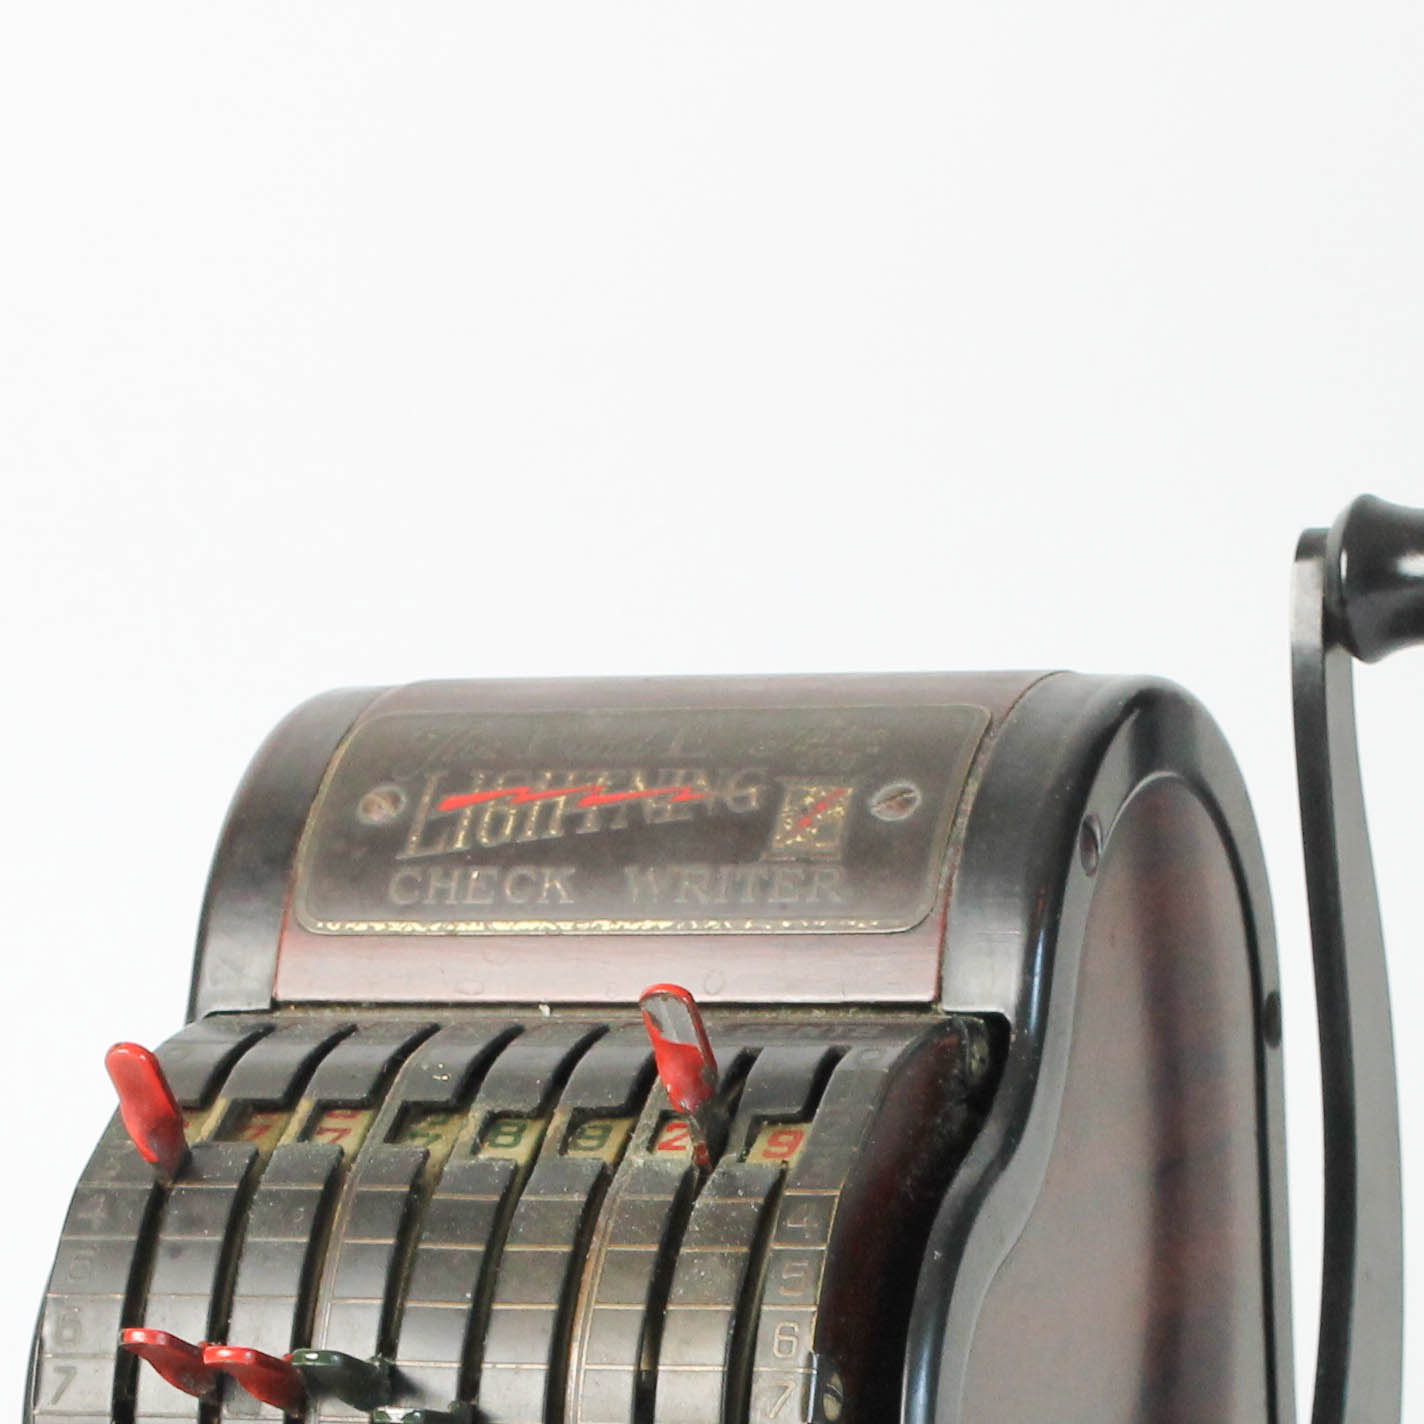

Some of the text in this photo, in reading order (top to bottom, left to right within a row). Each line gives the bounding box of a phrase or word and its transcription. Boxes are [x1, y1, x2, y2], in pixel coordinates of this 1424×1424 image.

[395, 768, 768, 860] LIGHTNING
[388, 864, 850, 905] CHECK WRITER
[488, 1120, 527, 1149] 8
[657, 1121, 690, 1151] 2
[762, 1129, 805, 1159] 9
[778, 1260, 810, 1297] 5
[773, 1321, 800, 1358] 6
[50, 1365, 78, 1406] 7
[768, 1379, 797, 1419] 7
